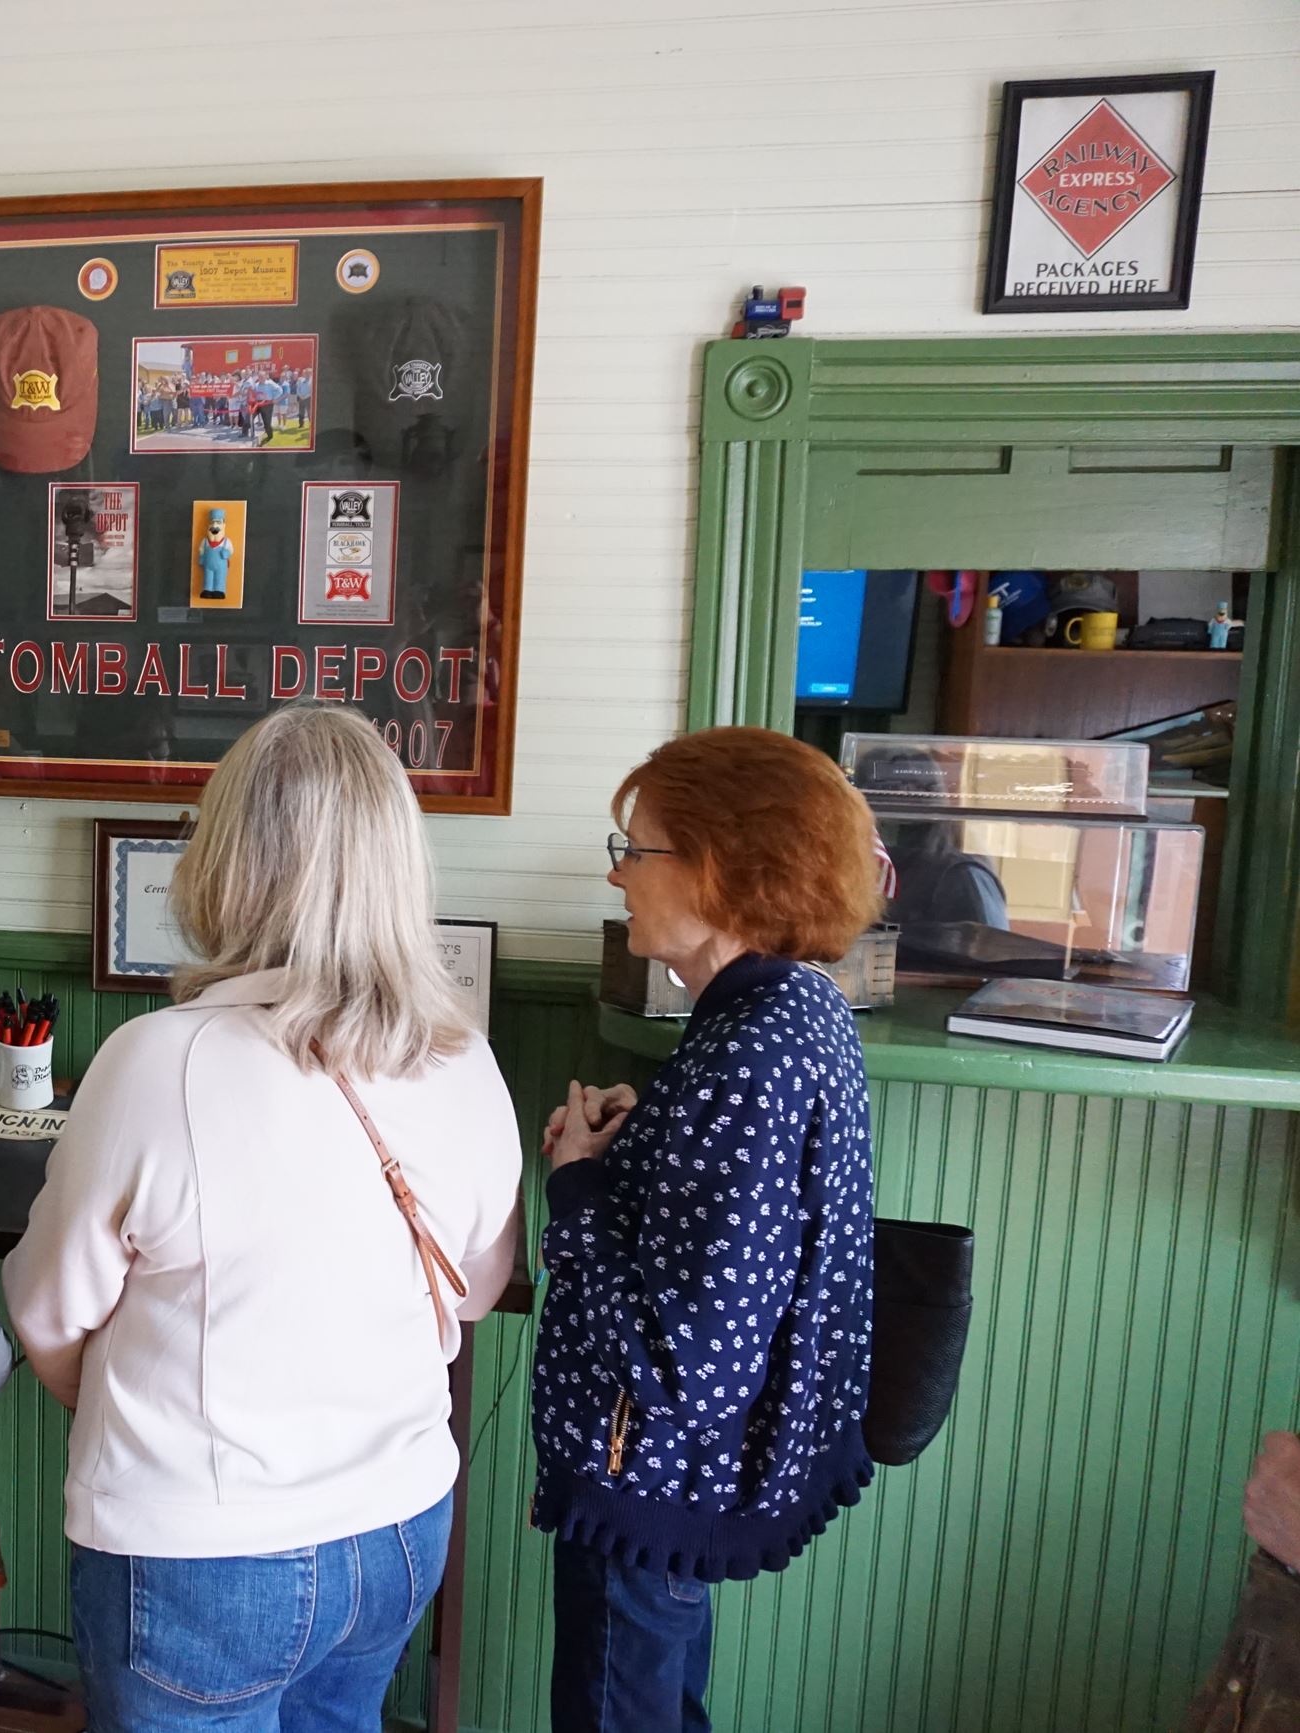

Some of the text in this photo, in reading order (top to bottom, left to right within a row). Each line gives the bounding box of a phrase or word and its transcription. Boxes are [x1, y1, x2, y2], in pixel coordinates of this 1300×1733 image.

[1042, 143, 1157, 179] RAILWAY
[1059, 171, 1136, 188] EXPRESS
[1037, 184, 1143, 217] AGENCY
[1036, 260, 1139, 278] PACKAGES
[1013, 278, 1159, 296] RECEIVED HERE
[20, 381, 50, 394] T&W
[103, 492, 123, 510] THE
[341, 501, 363, 511] VALLEY
[96, 513, 128, 532] DEPOT
[333, 577, 363, 589] T&W
[271, 643, 475, 704] DEPOT
